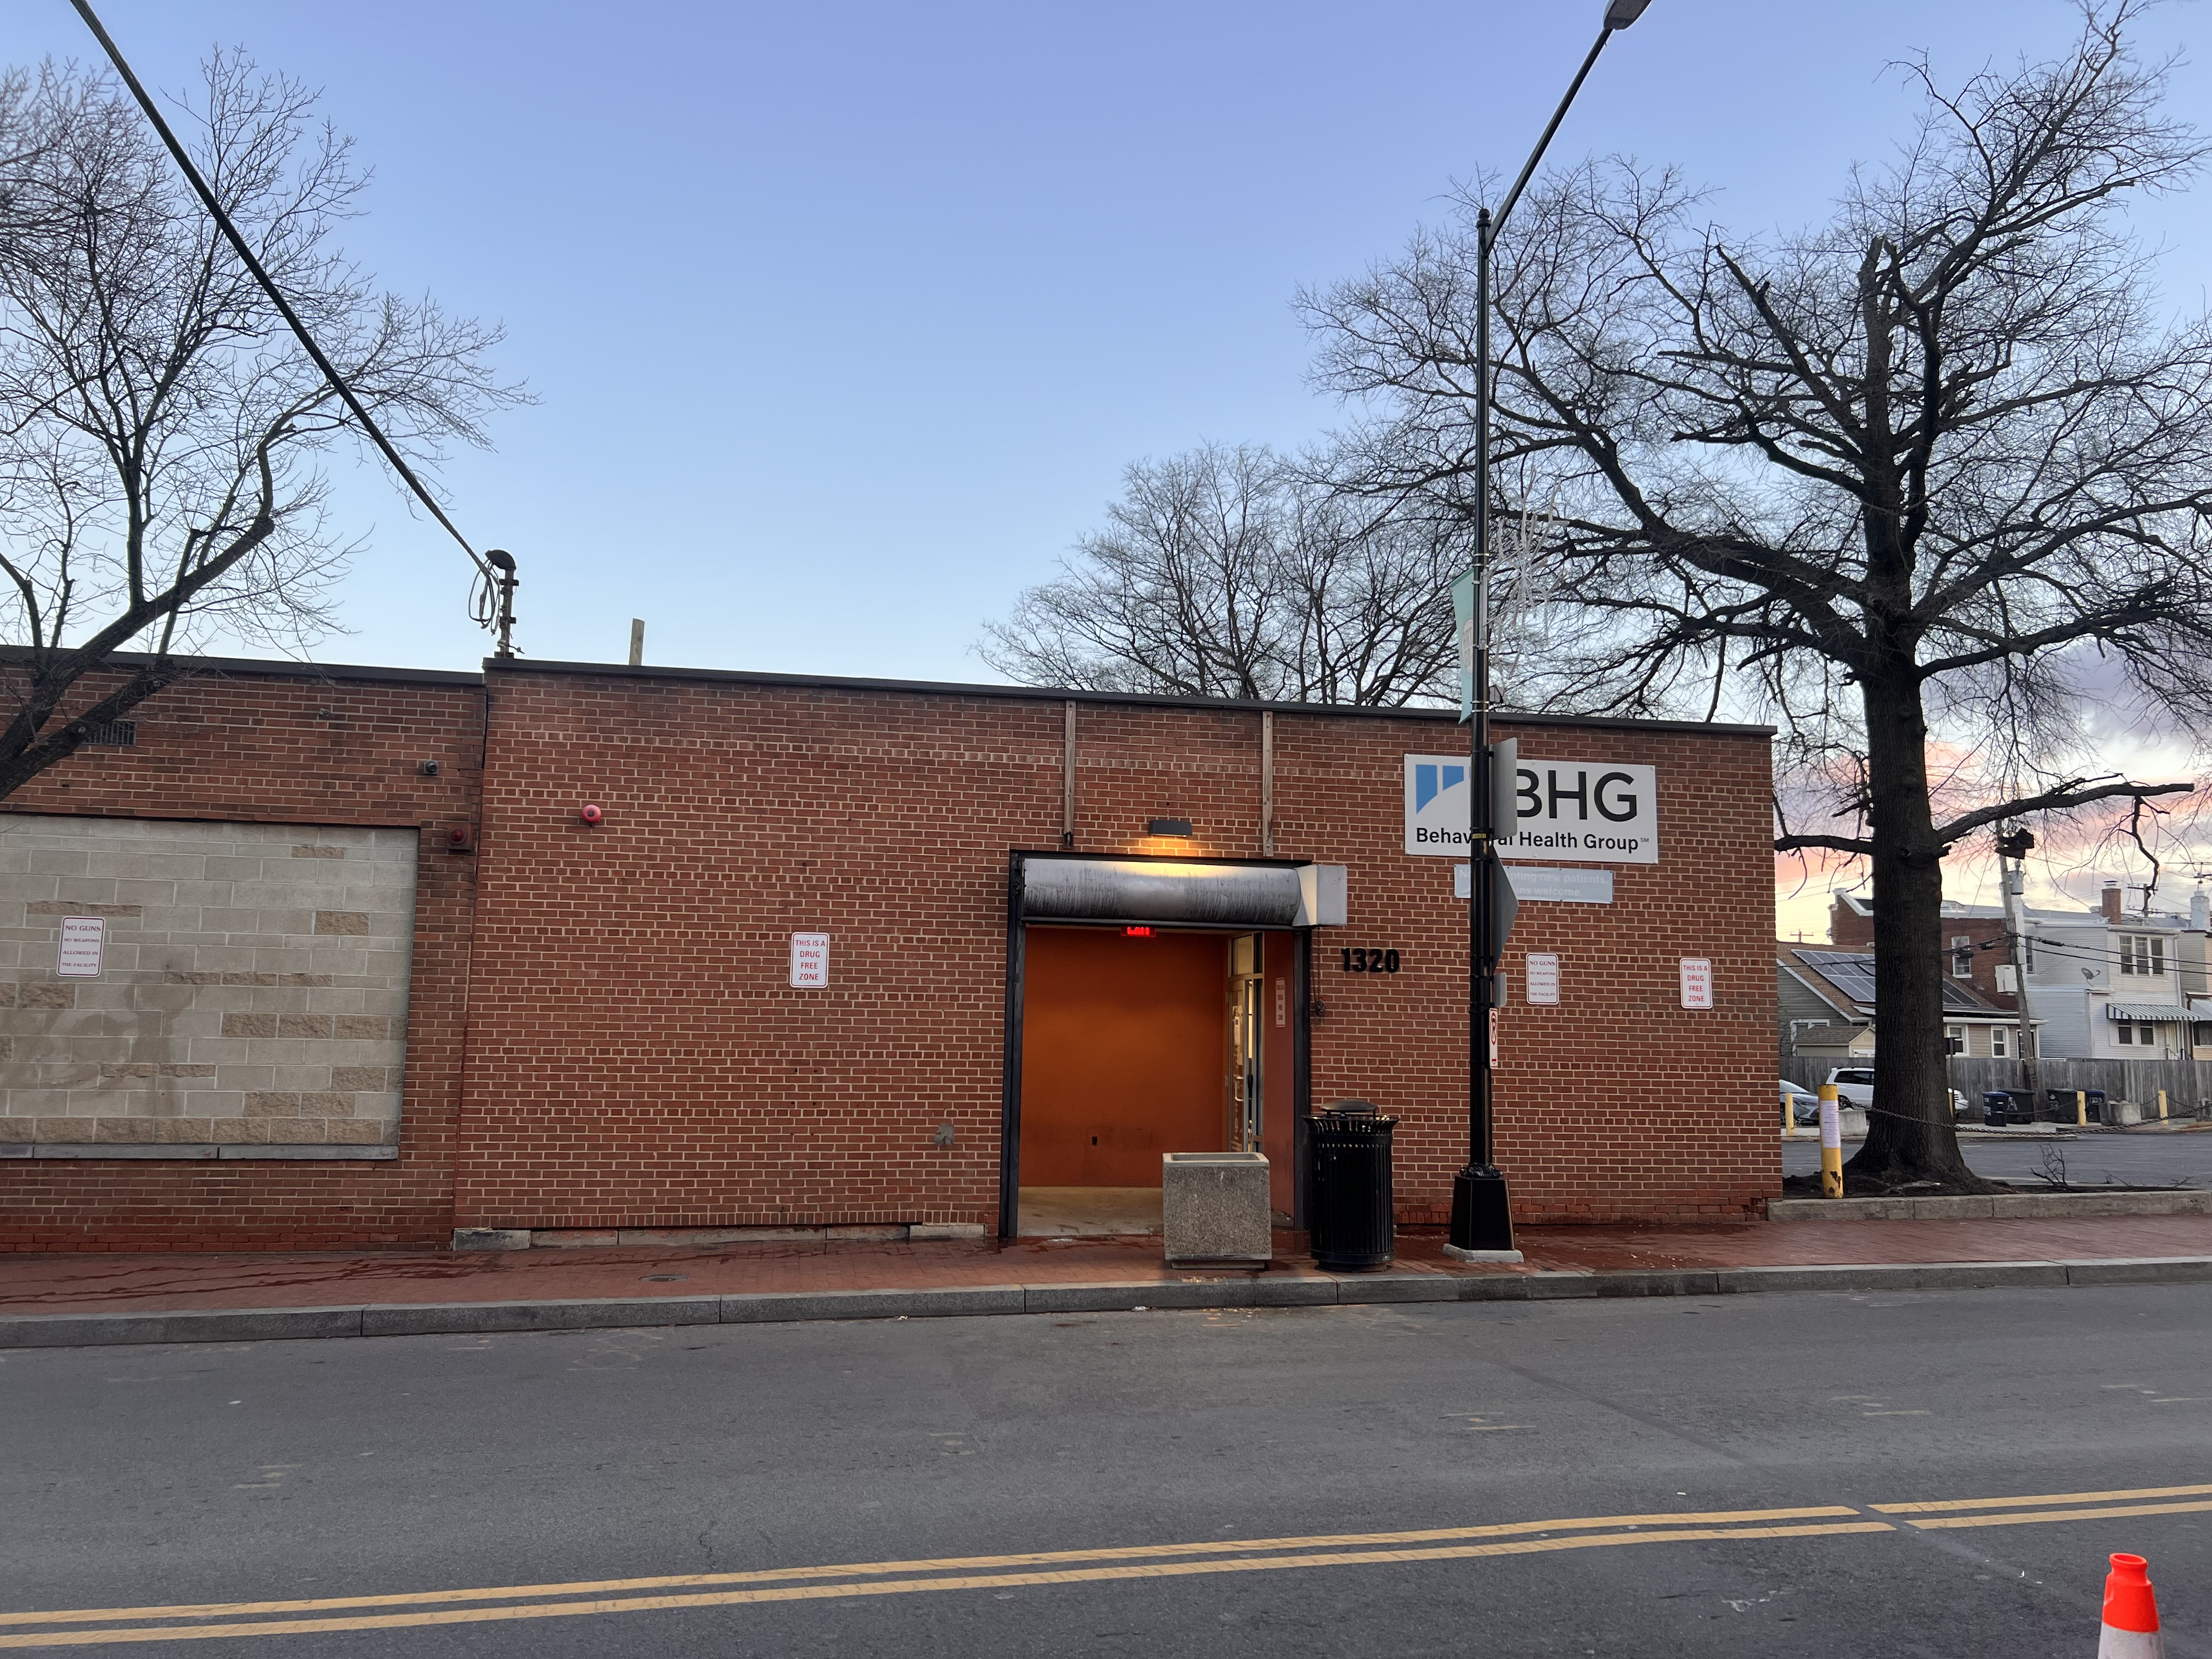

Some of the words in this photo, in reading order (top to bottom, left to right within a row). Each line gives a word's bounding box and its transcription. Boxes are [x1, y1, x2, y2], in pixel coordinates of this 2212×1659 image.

[1516, 768, 1637, 822] BHG
[1519, 831, 1577, 848] Health
[1584, 833, 1638, 854] Group
[1564, 873, 1608, 884] patients.
[1534, 886, 1583, 896] welcome.
[1341, 947, 1400, 973] 1320
